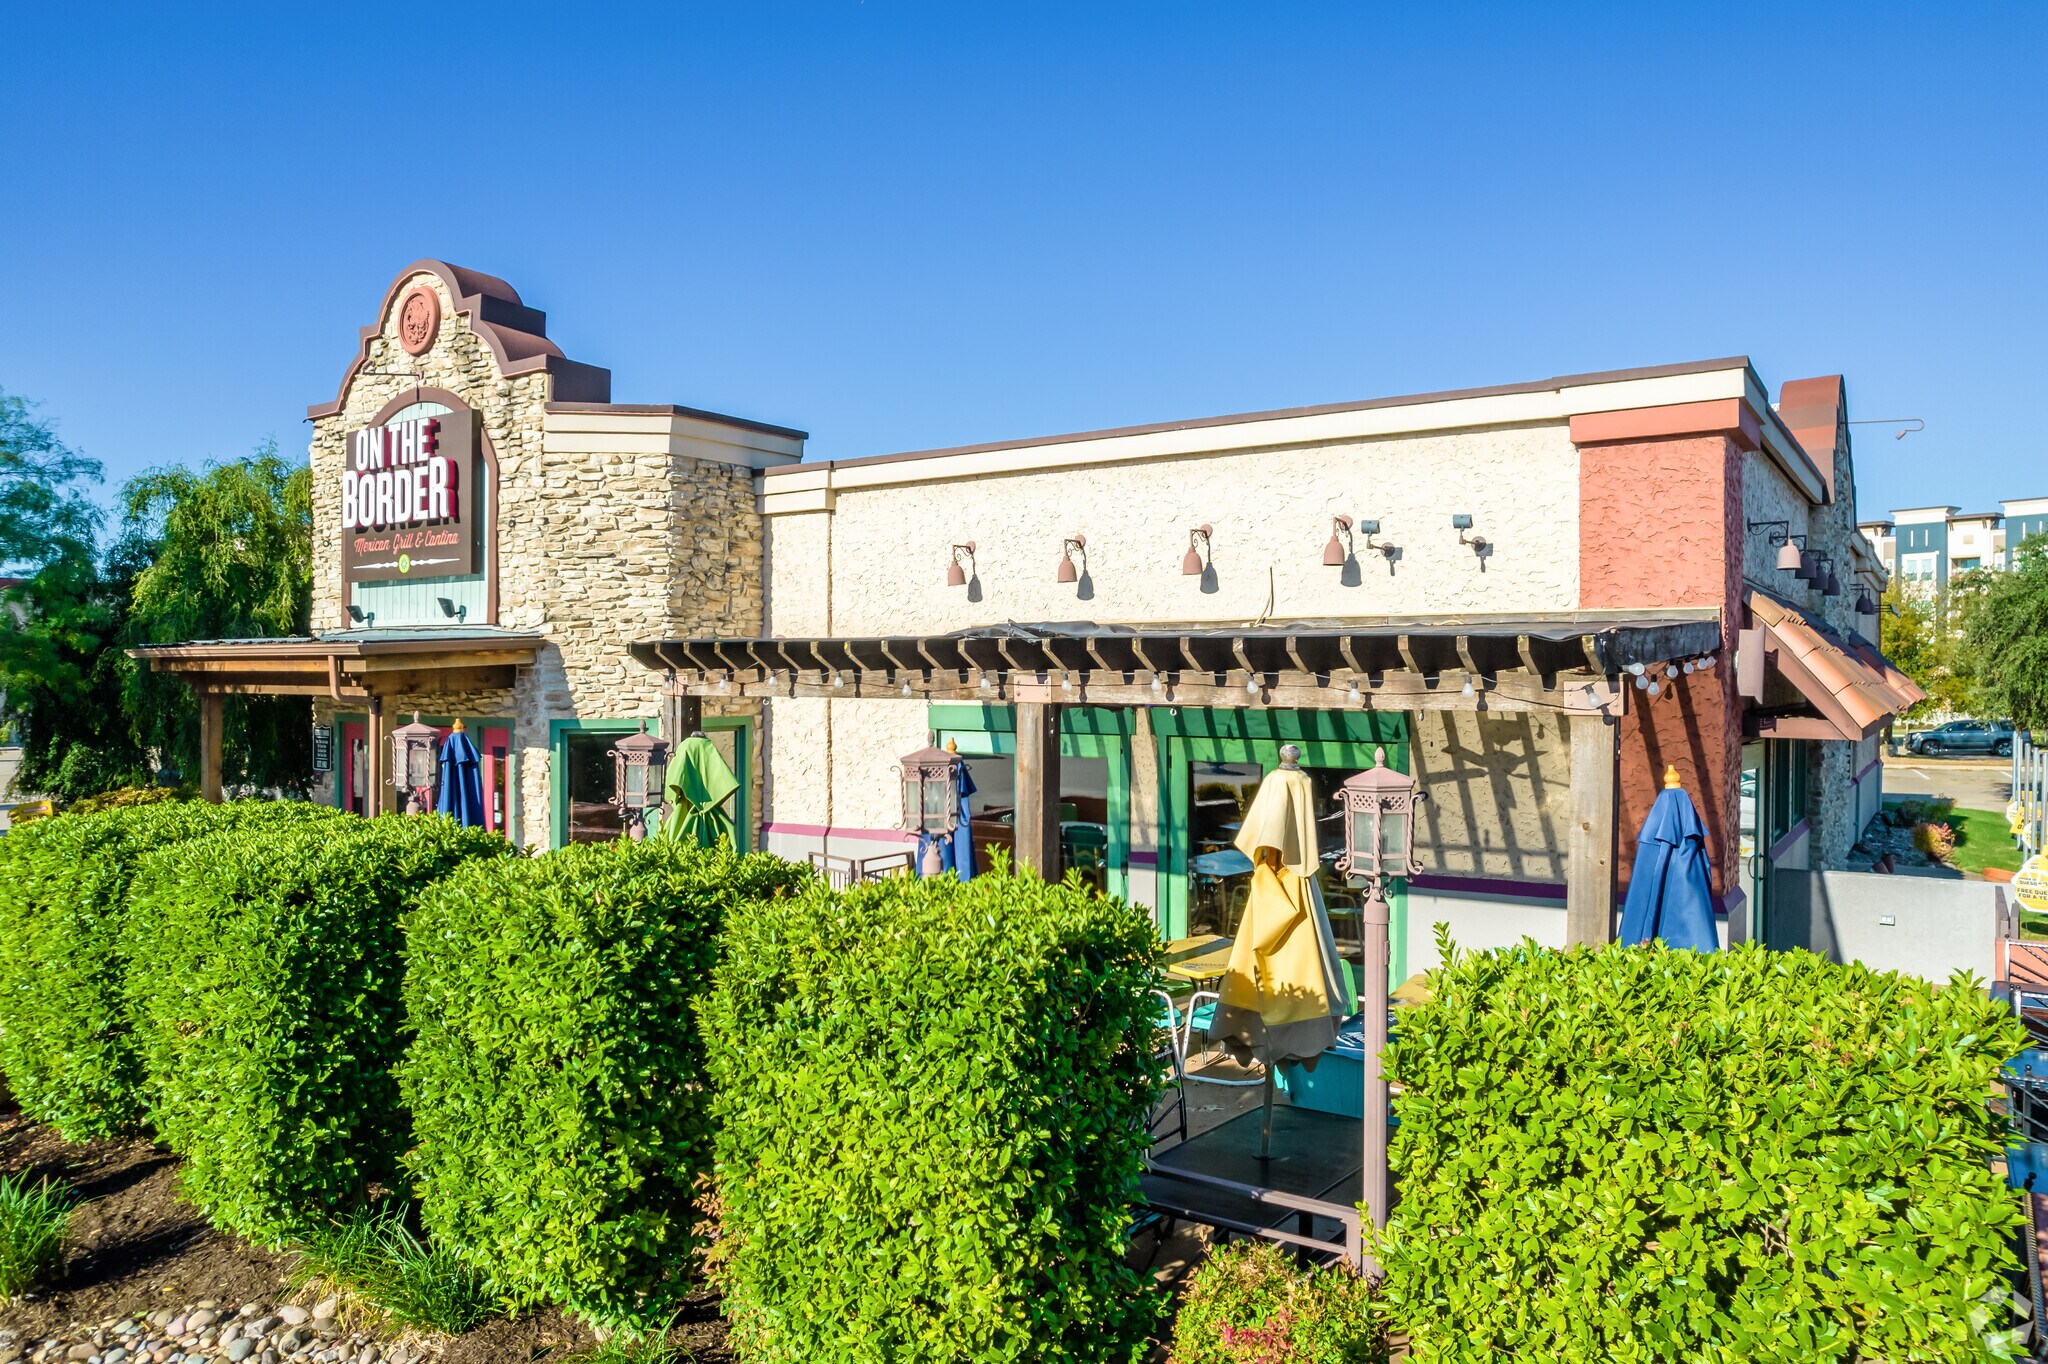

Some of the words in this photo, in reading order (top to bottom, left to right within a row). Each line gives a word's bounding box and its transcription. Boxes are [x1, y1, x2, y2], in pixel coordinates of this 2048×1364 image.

[356, 426, 384, 471] ON
[388, 417, 431, 466] THE
[342, 456, 450, 529] BORDER
[354, 538, 390, 556] Mexican
[393, 532, 413, 555] Grill
[415, 532, 424, 548] &
[424, 530, 459, 547] Cantina
